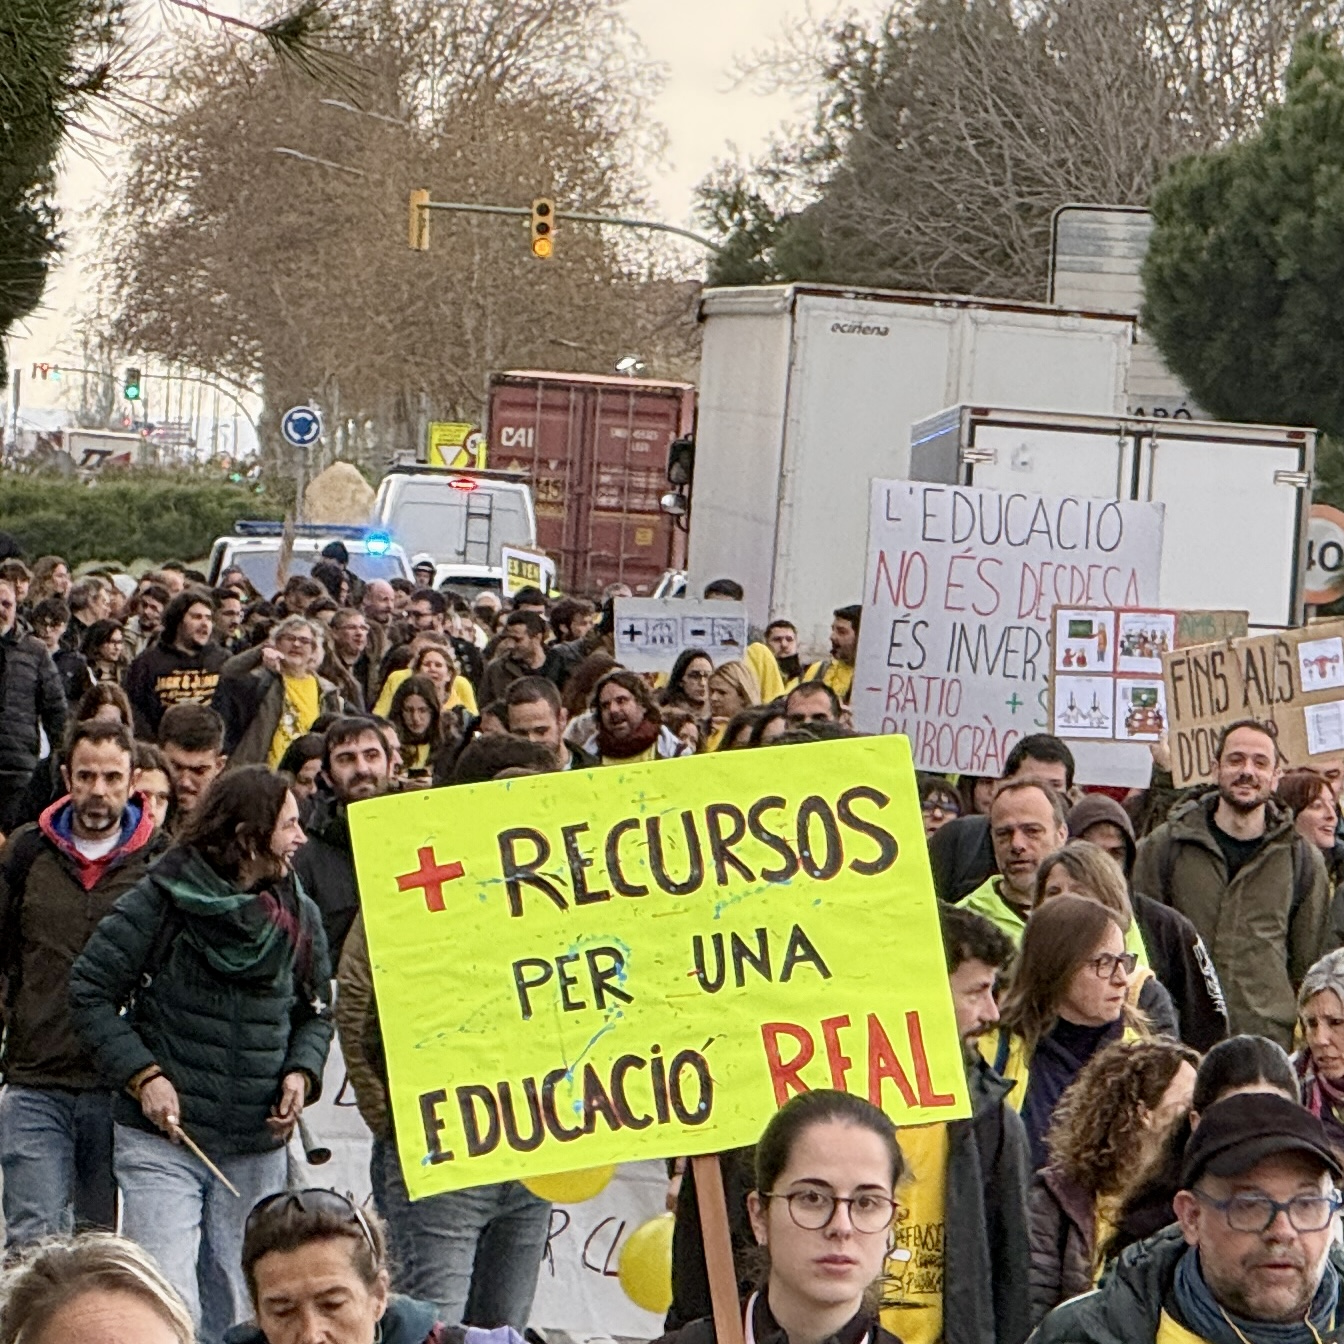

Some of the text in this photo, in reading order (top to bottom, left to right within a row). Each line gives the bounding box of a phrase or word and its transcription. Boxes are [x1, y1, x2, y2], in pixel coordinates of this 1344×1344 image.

[501, 427, 534, 447] CAI
[886, 487, 1123, 552] L'EDUCACIÓ
[872, 550, 928, 609] NO
[944, 547, 1003, 616] ÉS
[887, 613, 929, 670] ÉS
[1169, 648, 1230, 722] FINS
[1241, 640, 1295, 710] ALS
[497, 786, 899, 918] RECURSOS
[512, 923, 832, 1021] PER UNA
[420, 1035, 715, 1166] EDUCACIÓ
[761, 1010, 955, 1111] REAL
